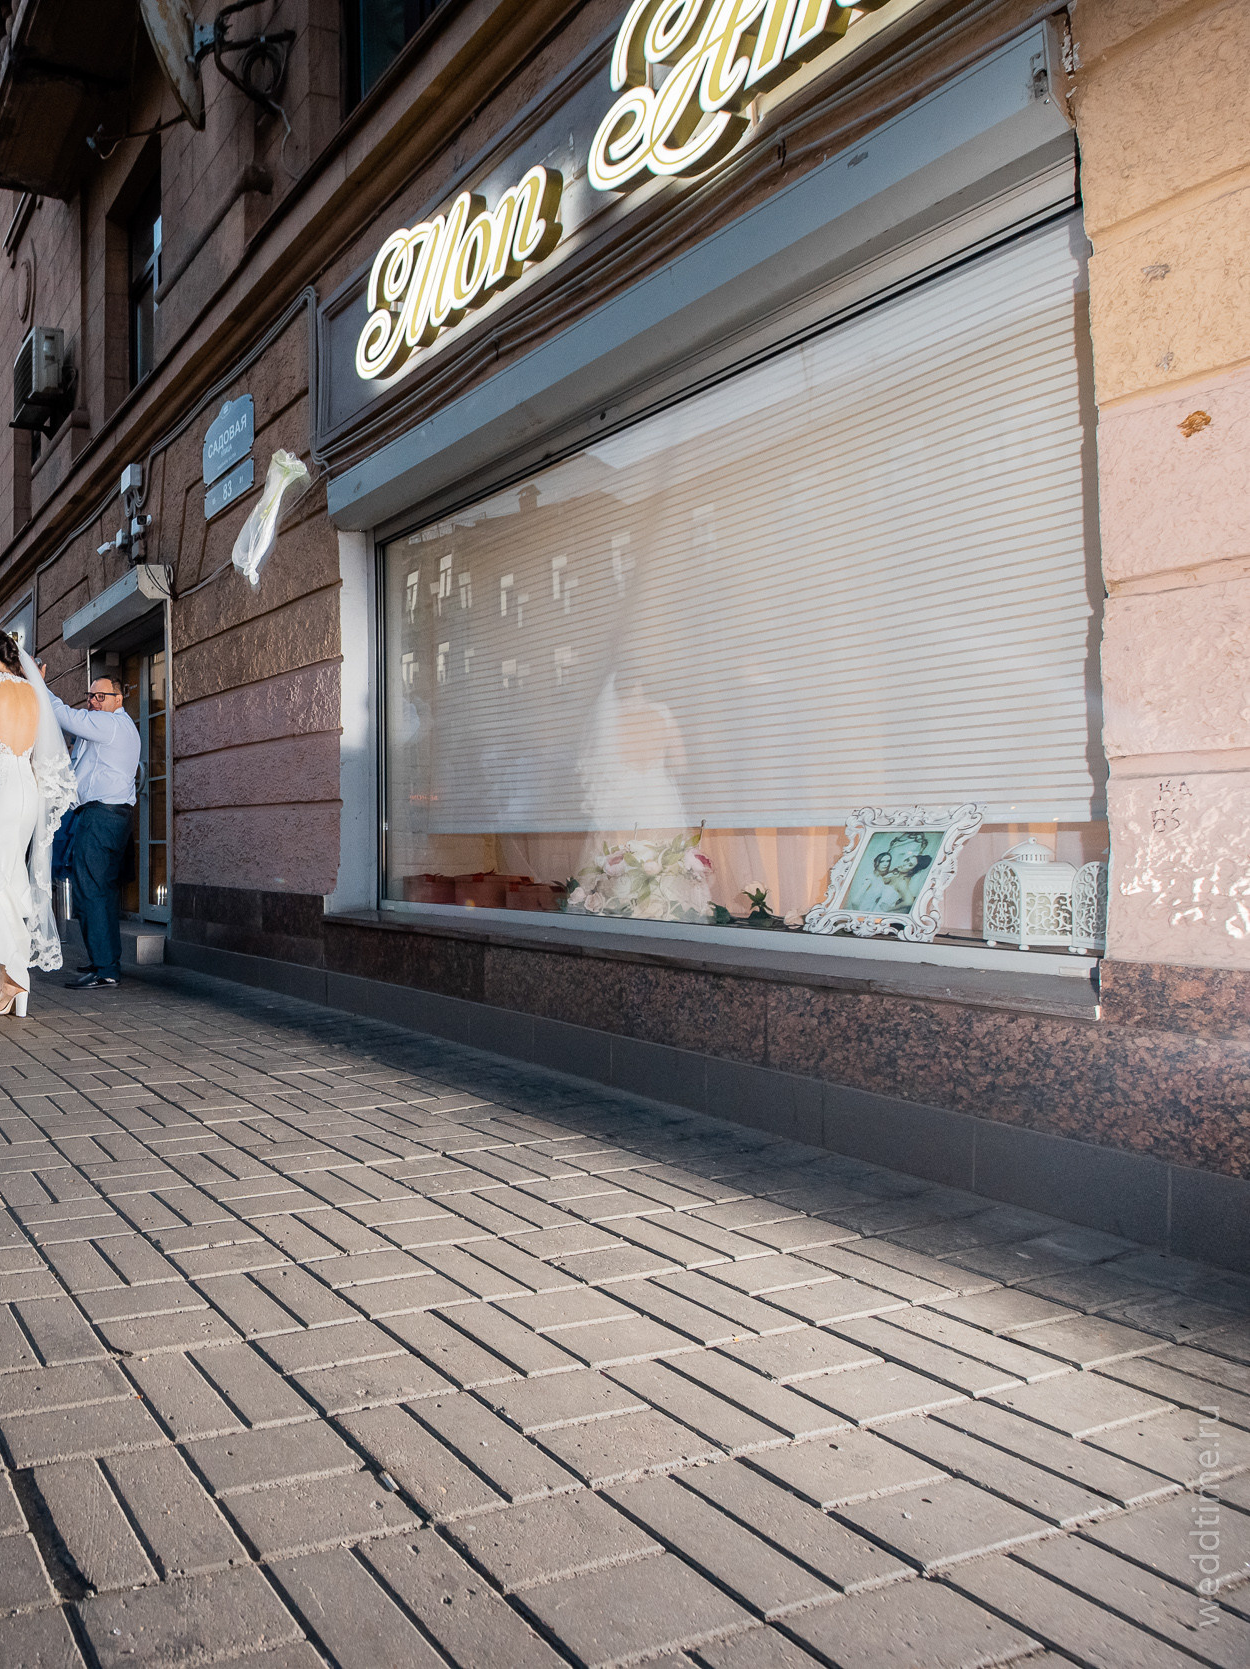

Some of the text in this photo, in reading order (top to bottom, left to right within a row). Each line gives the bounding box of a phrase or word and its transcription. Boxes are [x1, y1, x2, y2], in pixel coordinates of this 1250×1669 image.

[354, 164, 555, 380] Mon
[207, 413, 247, 459] САДОВАЯ
[222, 480, 232, 500] 83
